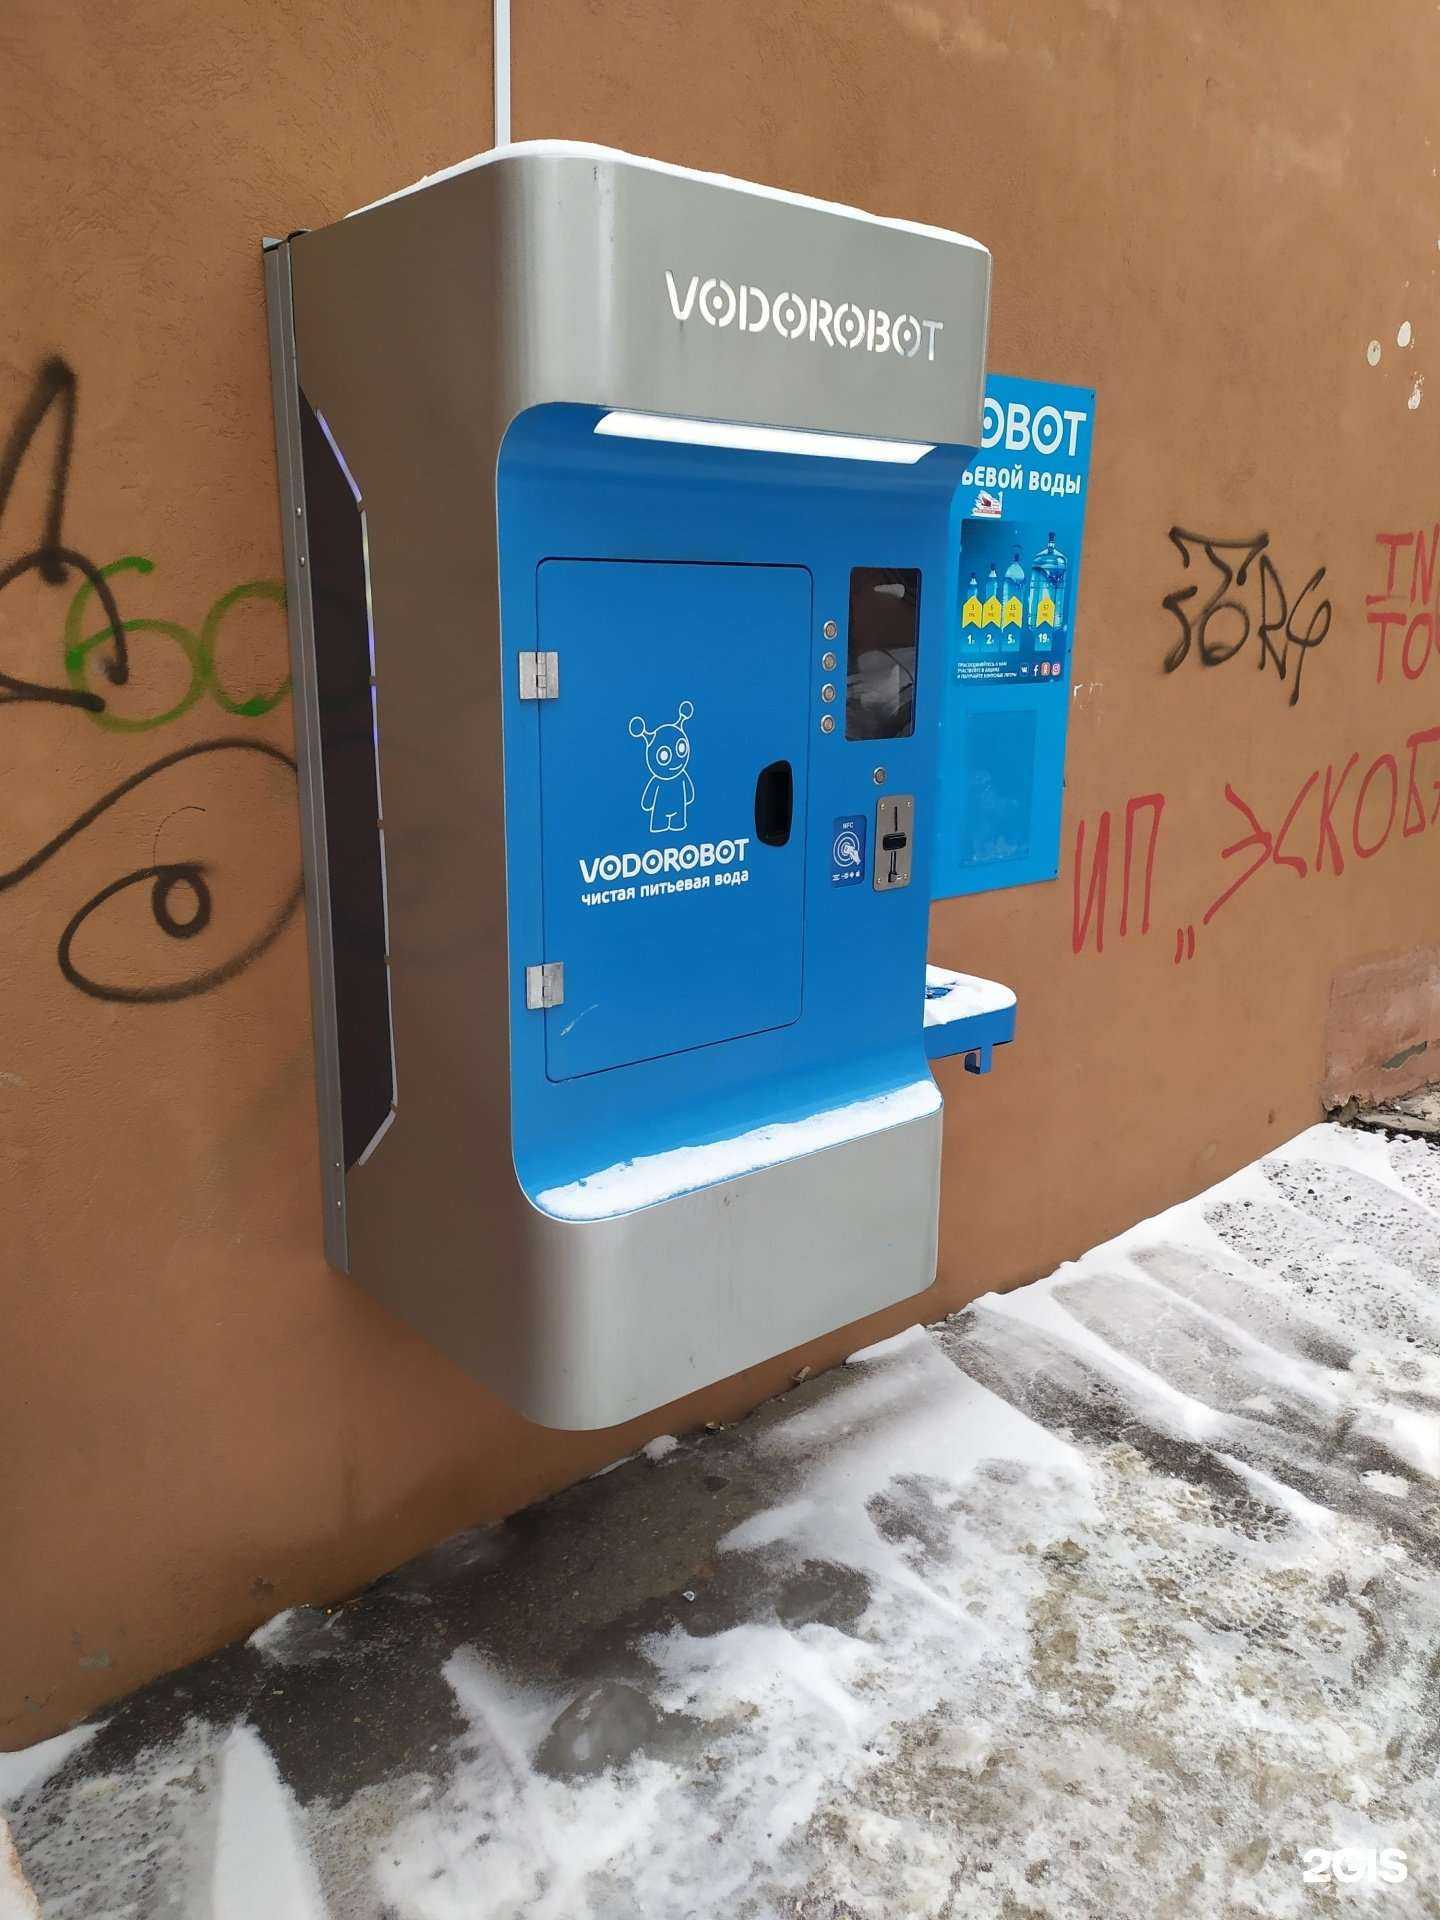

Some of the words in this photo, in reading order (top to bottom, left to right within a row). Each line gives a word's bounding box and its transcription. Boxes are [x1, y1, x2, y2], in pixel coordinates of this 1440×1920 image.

[665, 269, 944, 361] VODOROBOT
[1028, 470, 1081, 497] ВОДЫ
[579, 838, 750, 883] VODOROBOT
[581, 886, 636, 906] чистая
[640, 875, 710, 898] питьевая
[714, 869, 749, 887] вода
